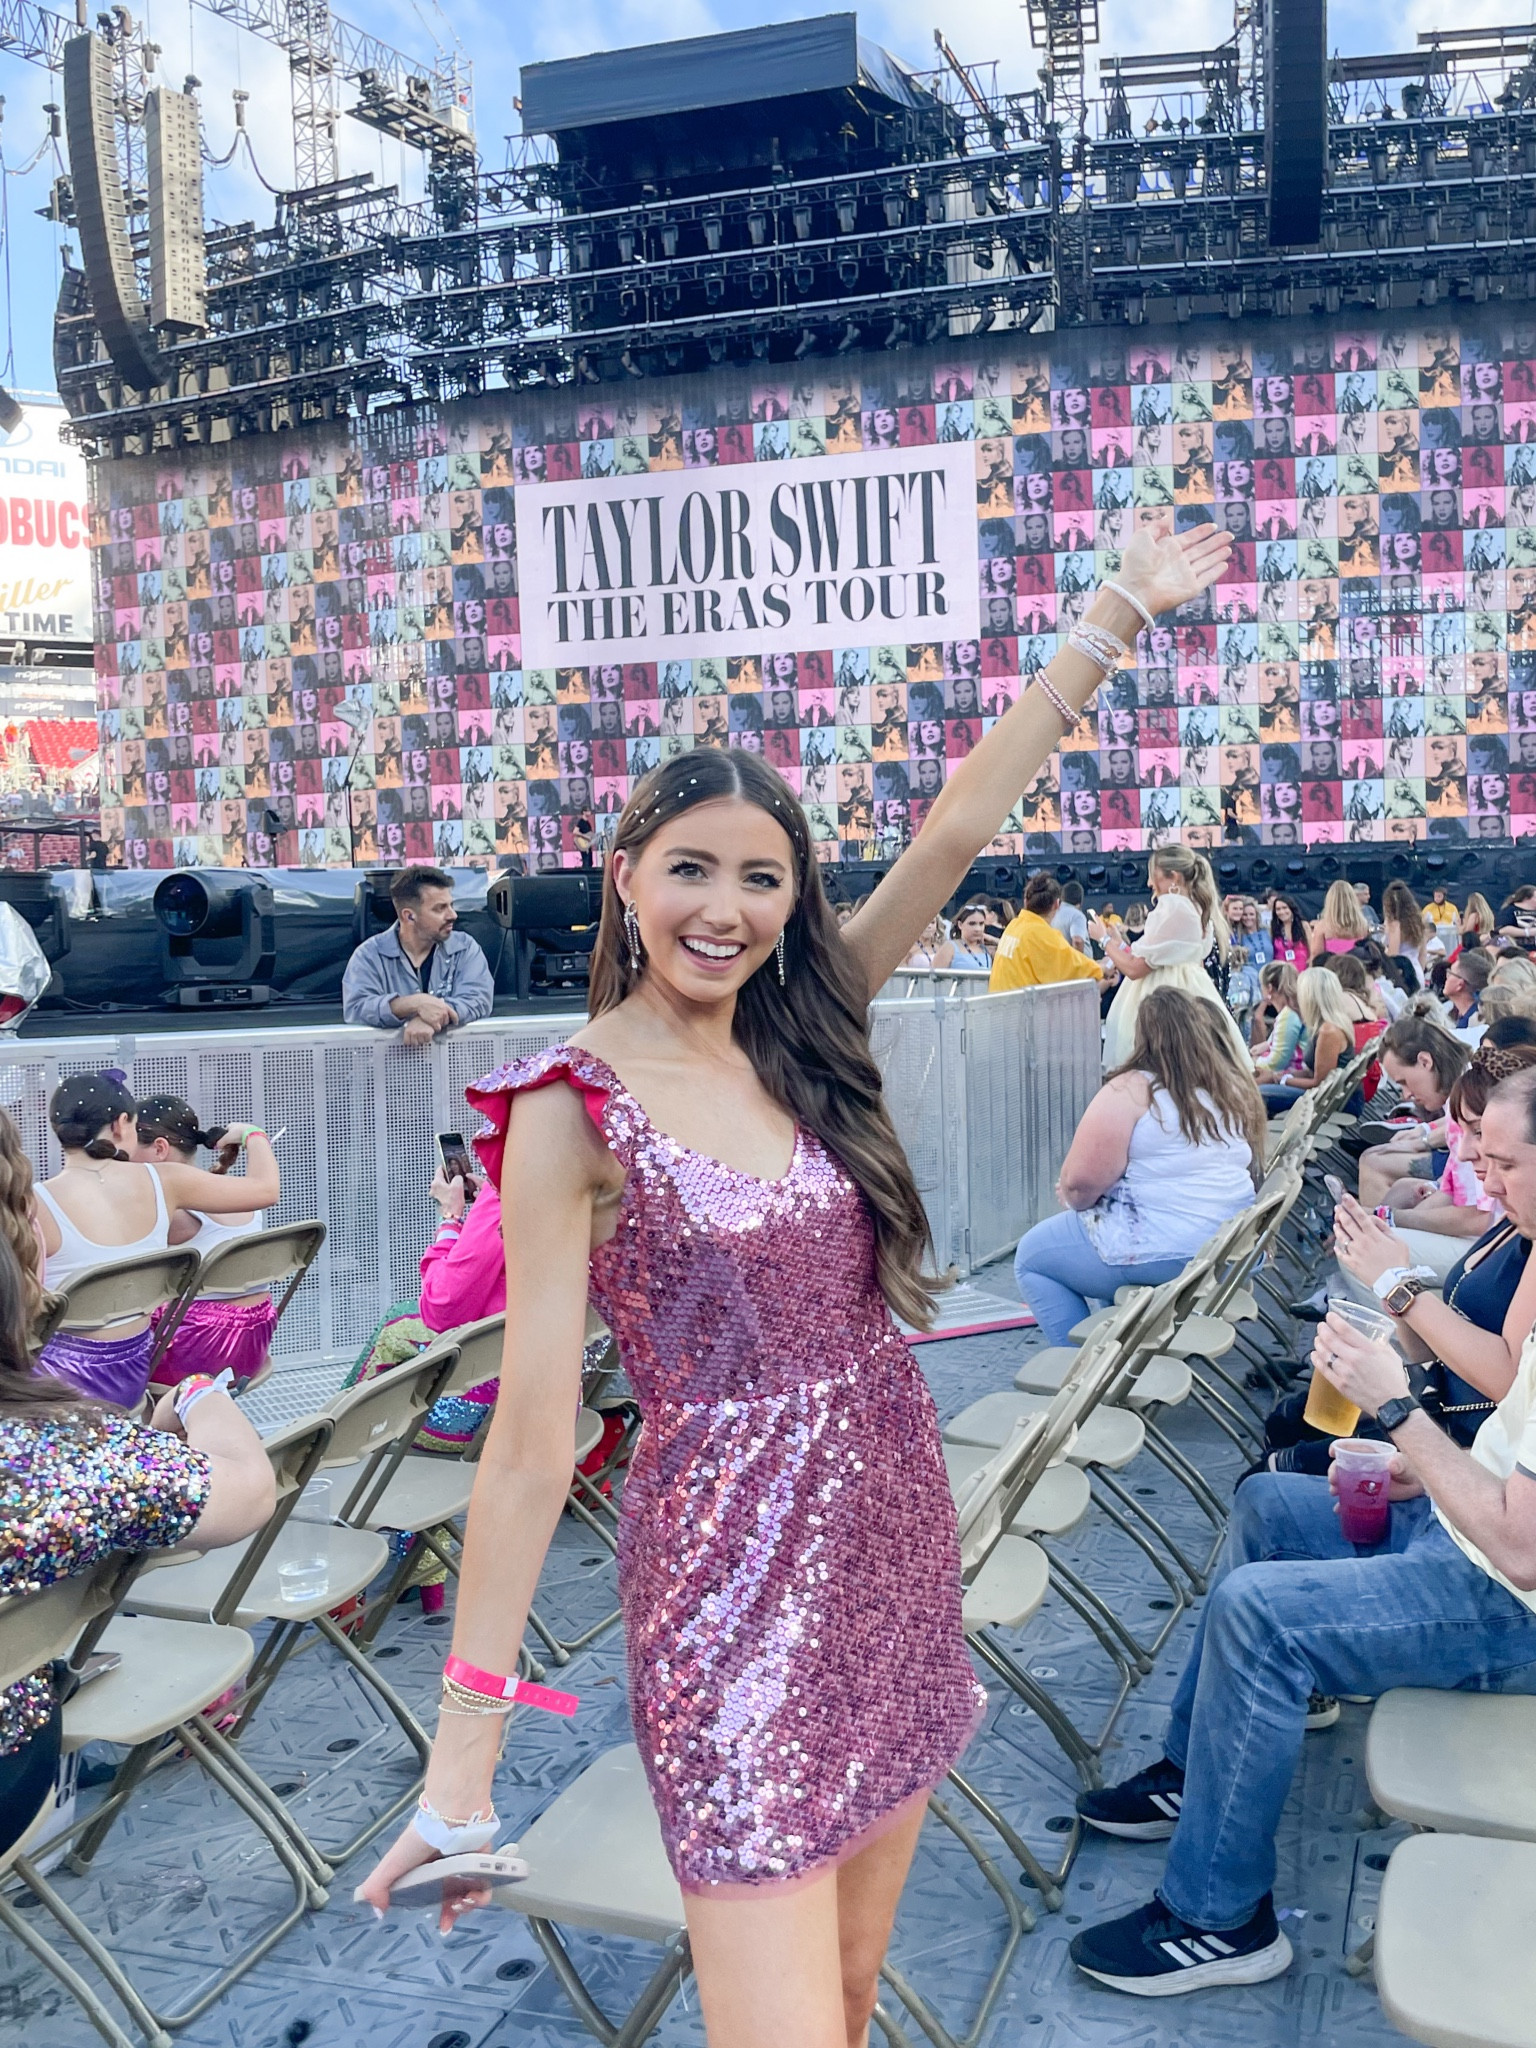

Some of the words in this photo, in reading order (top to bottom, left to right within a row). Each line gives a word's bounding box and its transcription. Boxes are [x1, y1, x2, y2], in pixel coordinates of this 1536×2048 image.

[543, 489, 756, 593] TAYLOR
[770, 470, 946, 577] SWIFT
[4, 612, 73, 634] TIME
[548, 595, 647, 643] THE
[660, 583, 791, 635] ERAS
[805, 571, 950, 624] TOUR
